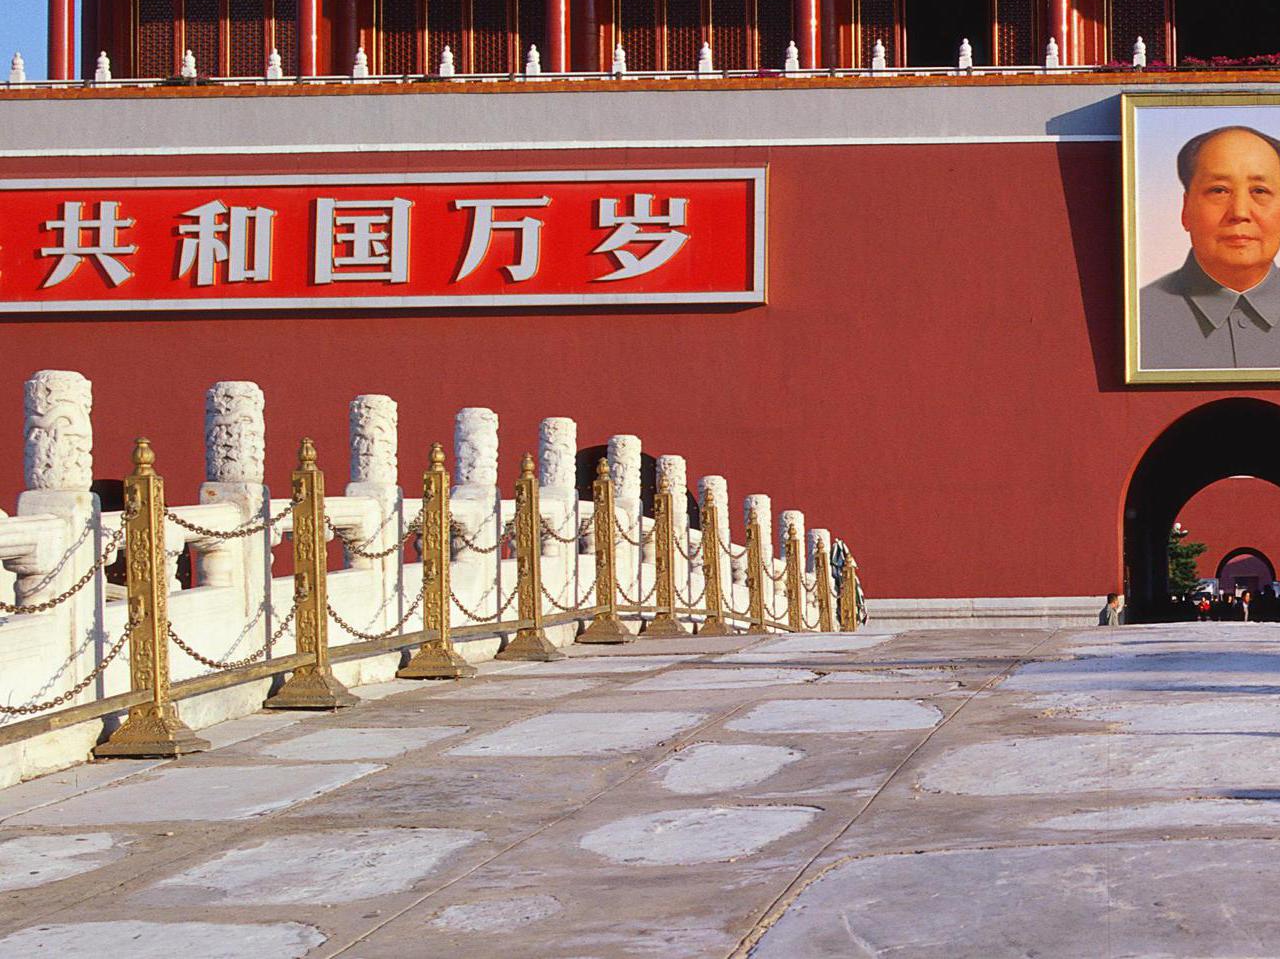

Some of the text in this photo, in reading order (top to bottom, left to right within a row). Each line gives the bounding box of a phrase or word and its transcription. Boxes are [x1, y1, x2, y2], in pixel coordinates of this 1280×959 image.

[40, 193, 691, 288] 共和国万岁
